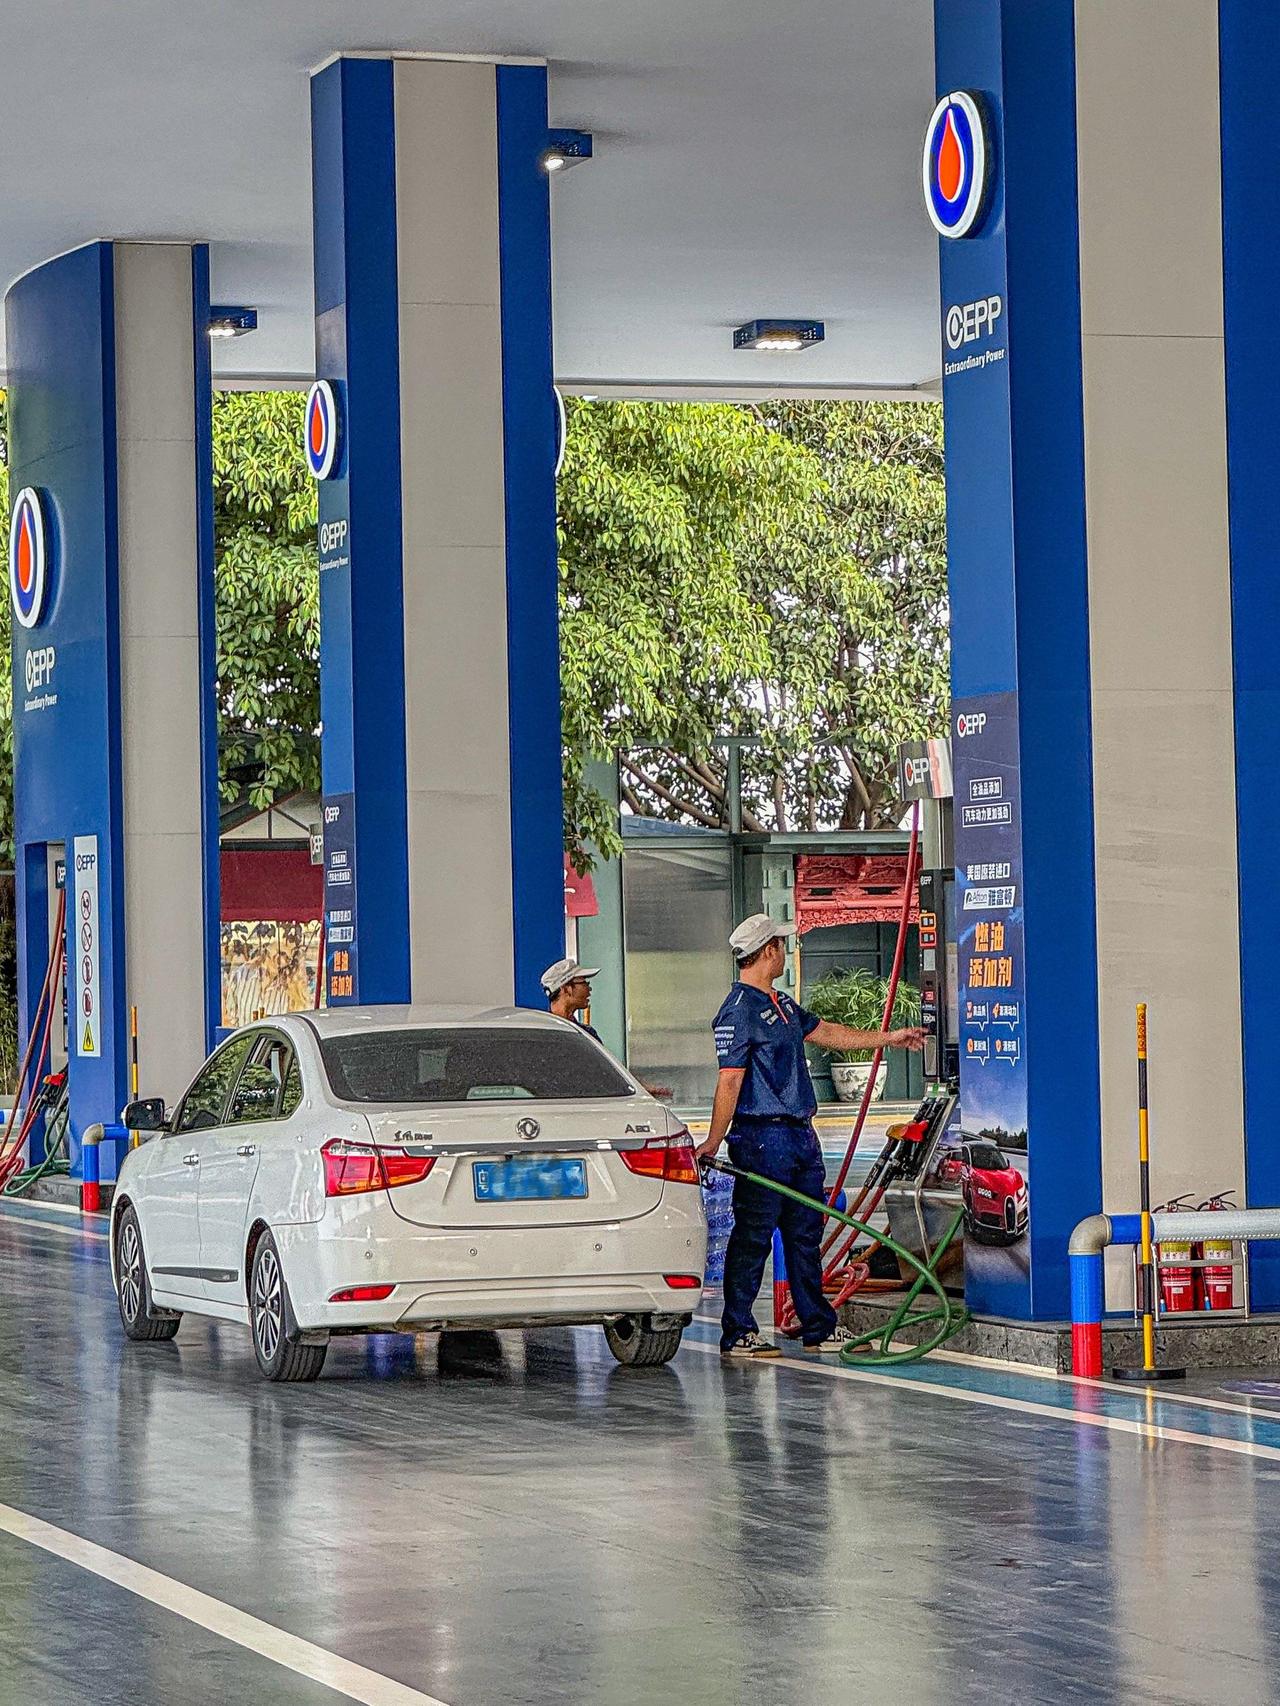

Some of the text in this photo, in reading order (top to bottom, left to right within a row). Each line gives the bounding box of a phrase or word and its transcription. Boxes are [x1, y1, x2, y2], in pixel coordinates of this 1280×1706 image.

[946, 295, 1002, 350] CEPP
[944, 349, 1005, 376] Extraordinary Power
[321, 520, 347, 554] CEPP
[25, 646, 55, 693] CEPP
[957, 712, 987, 738] CEPP
[975, 921, 1004, 952] 燃油
[969, 956, 1012, 988] 添加剂
